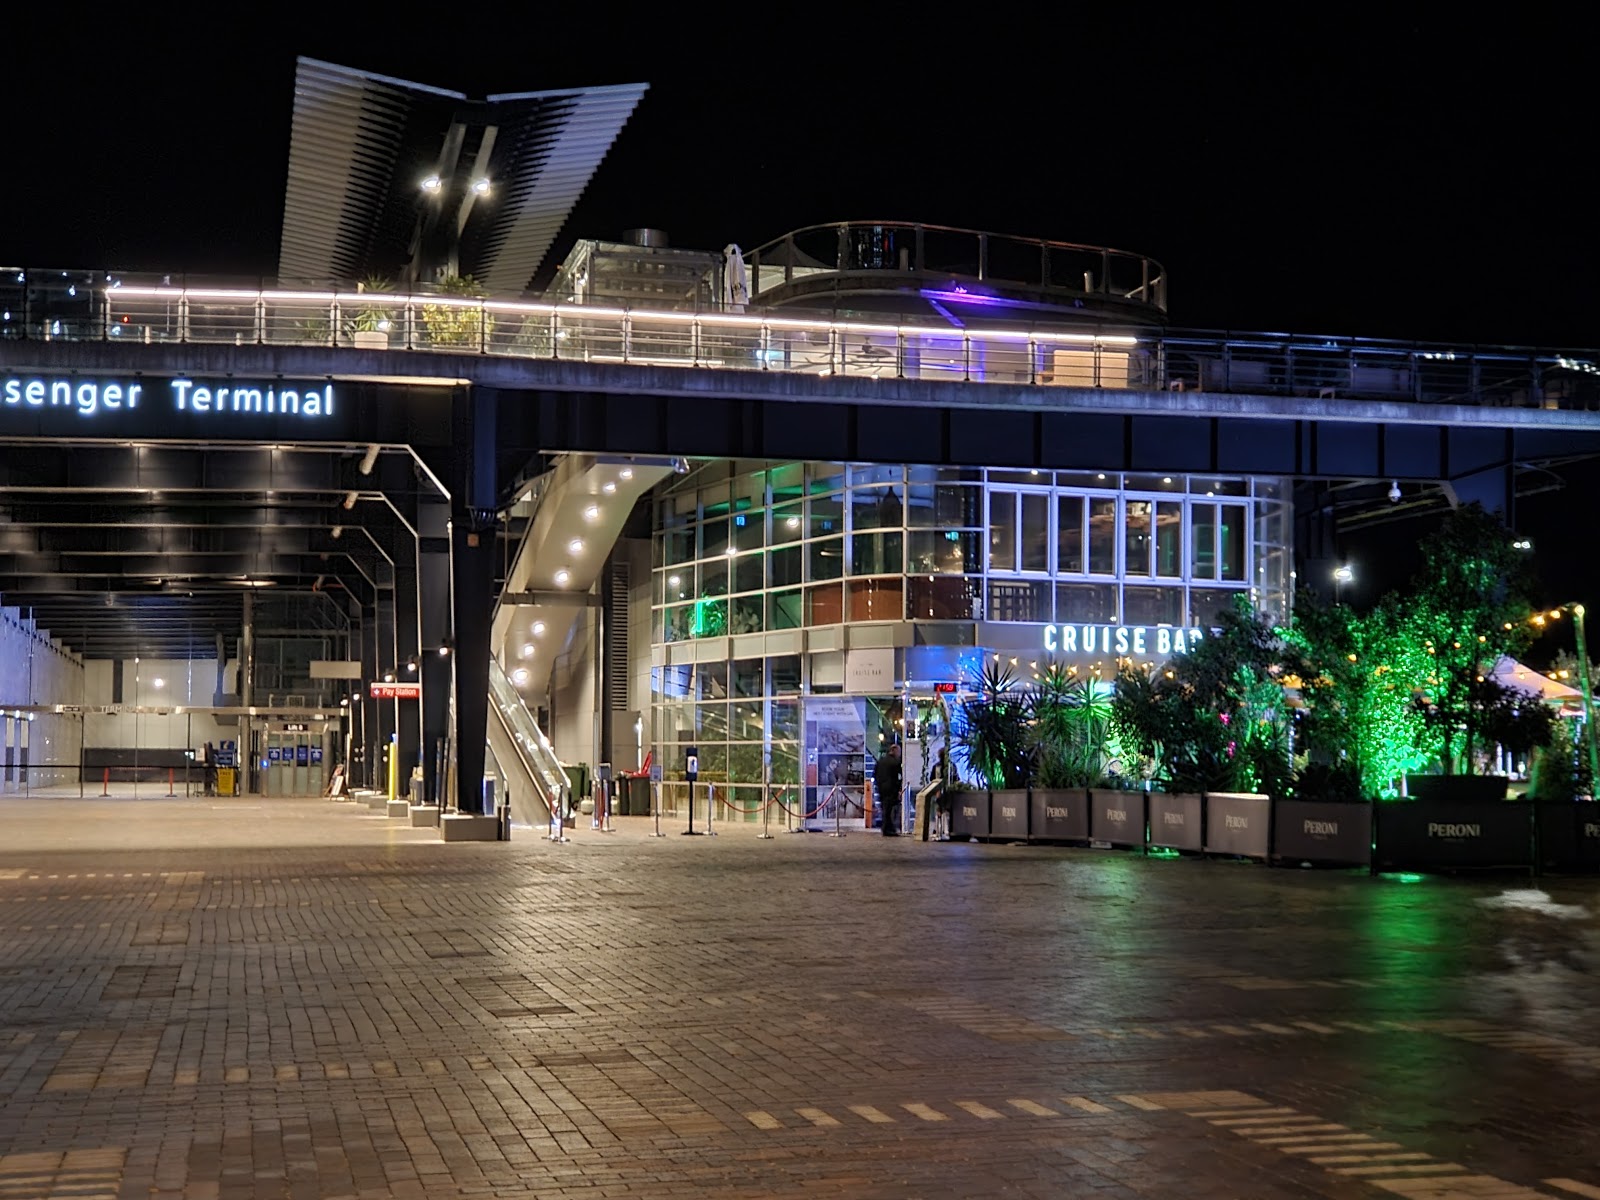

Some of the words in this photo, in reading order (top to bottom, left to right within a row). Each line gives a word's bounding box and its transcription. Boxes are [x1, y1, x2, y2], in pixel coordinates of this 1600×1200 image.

[171, 380, 333, 415] Terminal
[1044, 625, 1146, 653] CRUISE
[382, 688, 395, 697] Pay
[395, 688, 417, 696] Station
[1046, 806, 1069, 818] PERONI
[1106, 808, 1127, 821] PERONI
[1164, 812, 1184, 825] PERONI
[1225, 814, 1248, 829] PERONI
[1304, 819, 1339, 835] PERONI
[1428, 822, 1481, 838] PERONI
